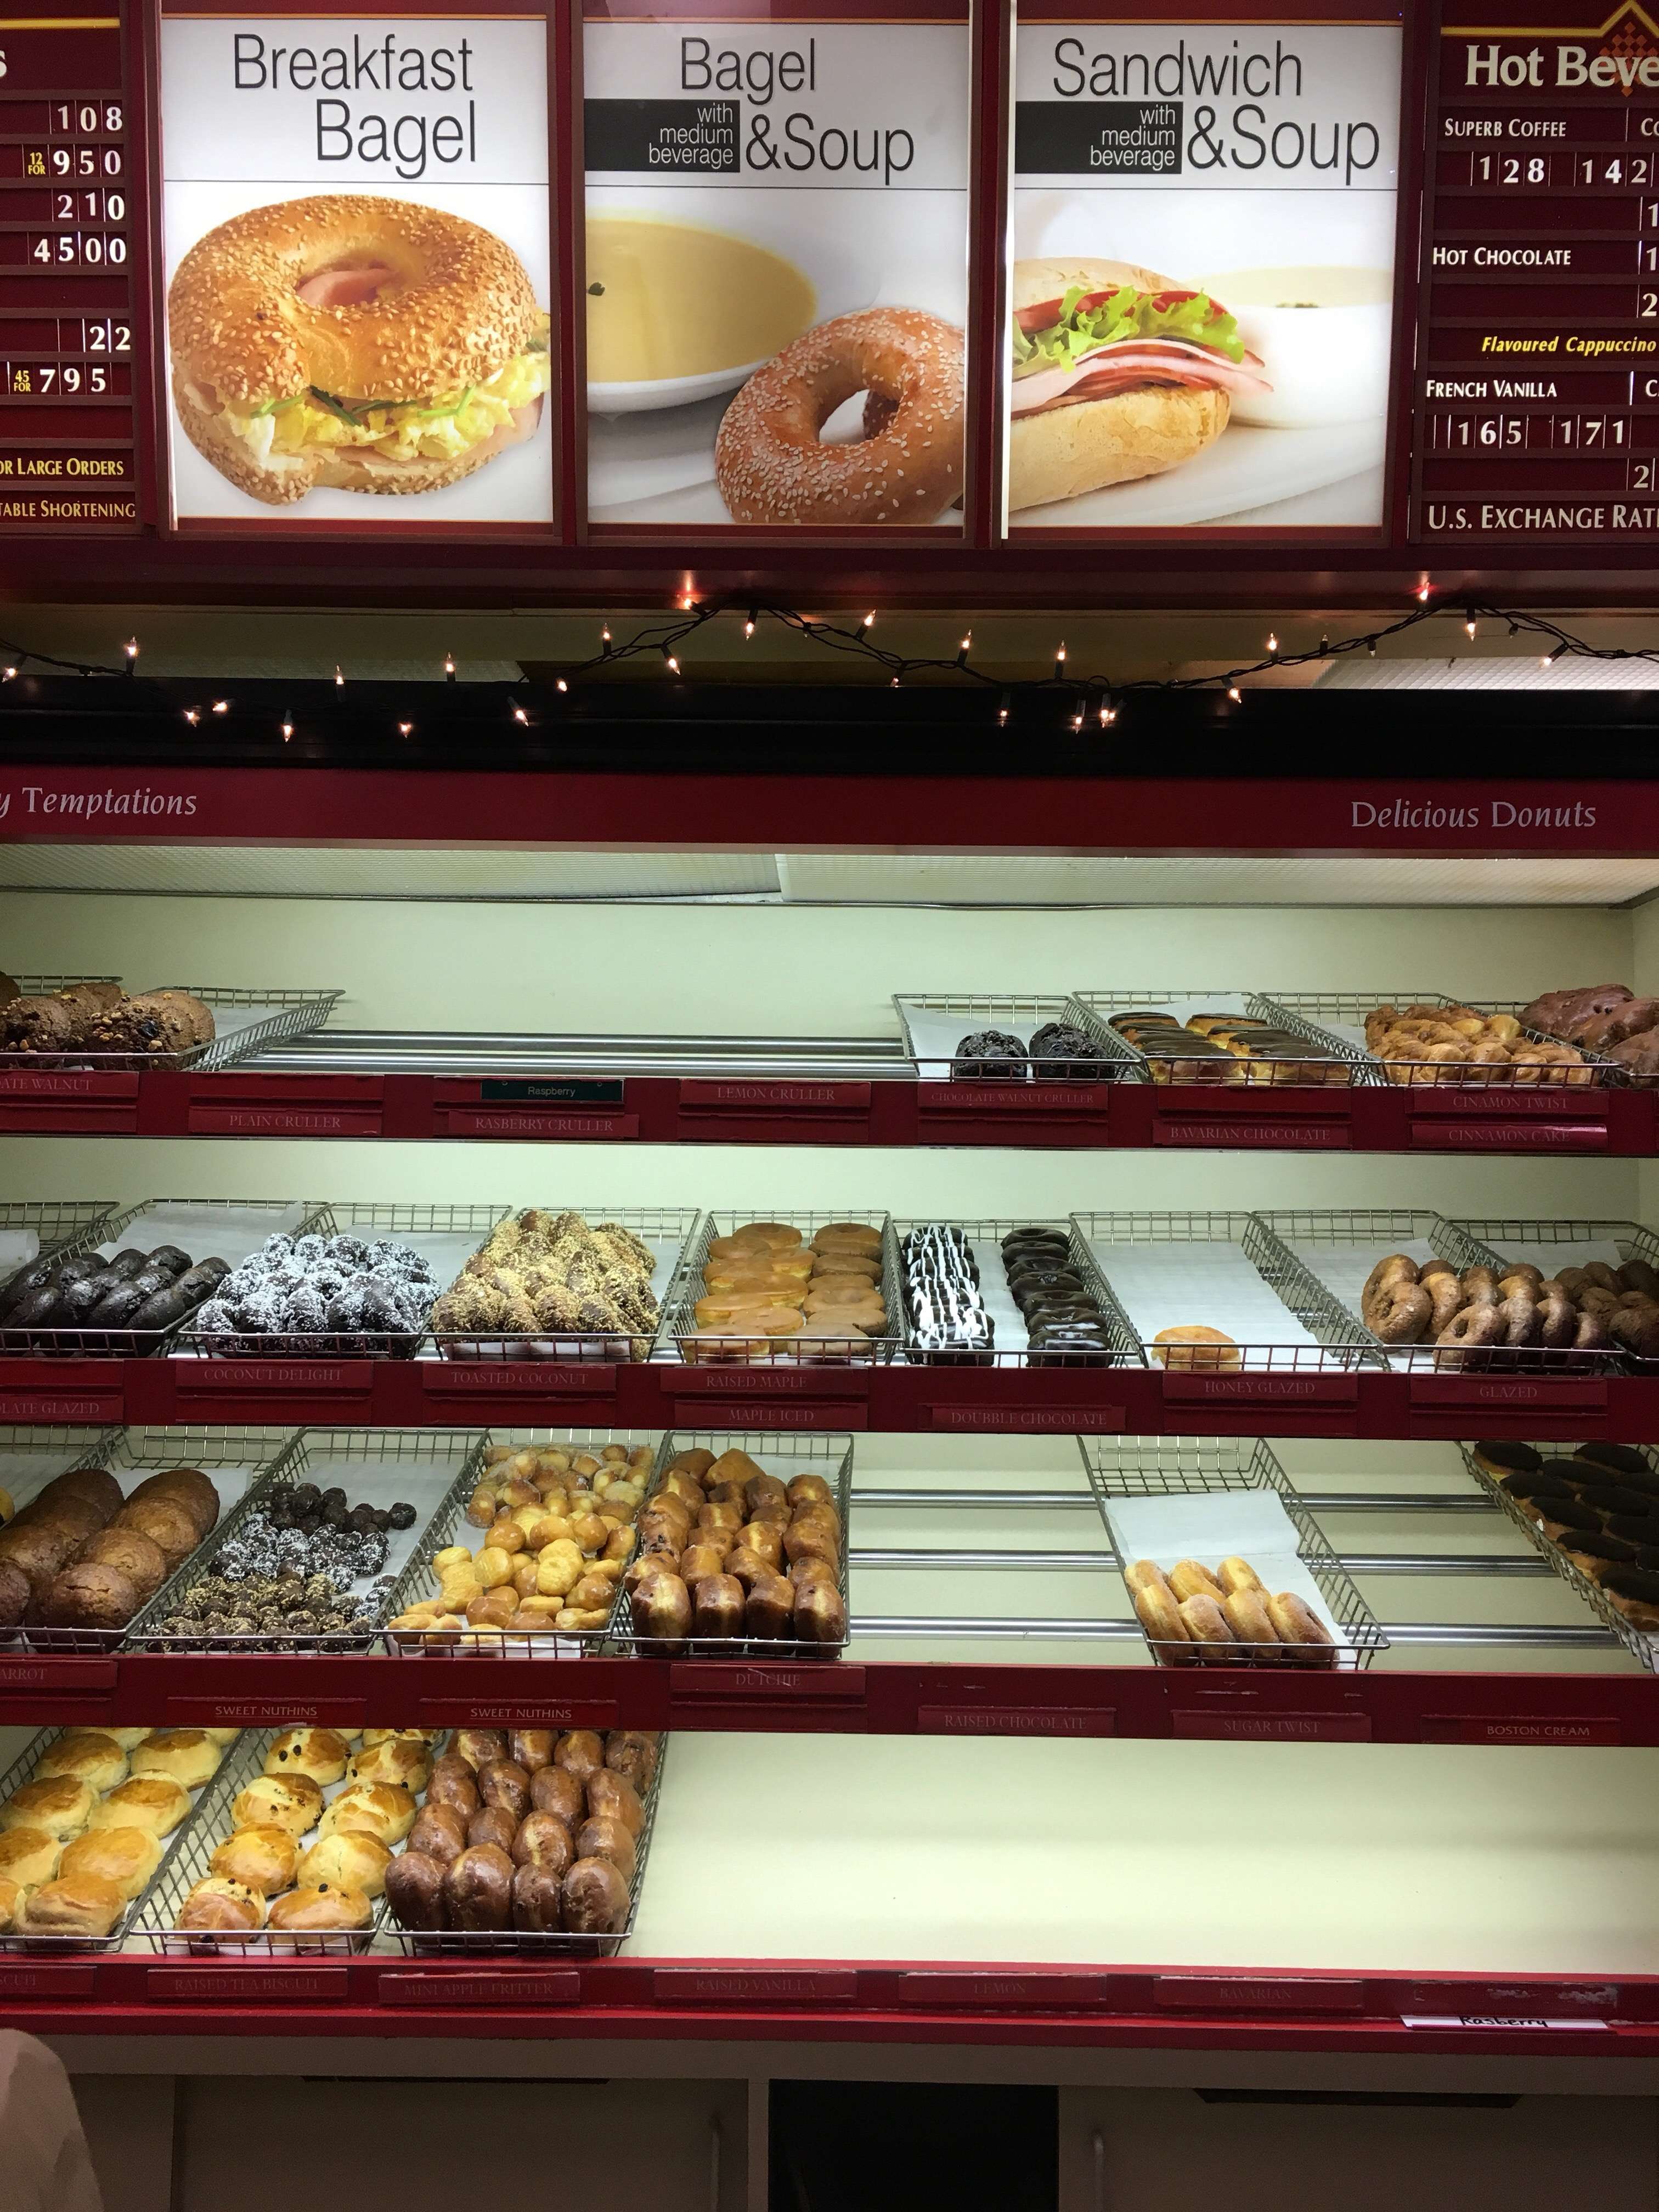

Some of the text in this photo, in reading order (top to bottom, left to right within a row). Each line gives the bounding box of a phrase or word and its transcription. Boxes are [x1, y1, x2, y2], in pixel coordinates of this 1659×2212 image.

[234, 33, 473, 92] Breakfast
[1053, 38, 1301, 97] Sandwich
[1465, 44, 1659, 88] Hot Beve
[681, 37, 815, 105] Bagel
[697, 103, 733, 123] with
[1140, 105, 1176, 125] with
[659, 125, 733, 144] medium
[1444, 118, 1566, 137] SUPERB COFFEE
[316, 99, 476, 179] Bagel
[1102, 126, 1176, 146] medium
[746, 113, 914, 185] &Soup
[1187, 104, 1379, 185] &Soup
[30, 152, 43, 166] 12
[649, 144, 733, 169] beverage
[1090, 145, 1176, 171] beverage
[28, 166, 46, 175] FOR
[1433, 247, 1571, 266] HOT CHOCOLATE
[1482, 336, 1656, 357] Flavoured Cappuccino
[15, 370, 29, 382] 45
[14, 382, 31, 392] FOR
[1426, 380, 1557, 397] FRENCH VANILLA
[18, 458, 63, 475] LARGE
[66, 457, 124, 476] ORDERS
[41, 500, 136, 518] SHORTENING
[1429, 504, 1659, 529] U.S. EXCHANGE RAT
[22, 787, 197, 820] Temptations
[1351, 798, 1596, 827] Delicious Donuts
[32, 1079, 92, 1091] WALNUT
[527, 1086, 576, 1098] Raspberry
[717, 1087, 836, 1100] LEMON CRULLER
[931, 1092, 1094, 1103] CHOCOLATE WALNUT CRULLER
[1453, 1096, 1569, 1109] CINAMON TWIST
[229, 1115, 342, 1128] PLAIN CRULLER
[475, 1117, 614, 1131] RASBERRY CRULLER
[1171, 1127, 1331, 1141] BAVARIAN CHOCOLATE
[1449, 1130, 1571, 1142] CINNAMON CAKE
[204, 1368, 343, 1381] COCONUT DELIGHT
[450, 1371, 589, 1385] TOASTED COCONUT
[706, 1375, 807, 1388] RAISED MAPLE
[1205, 1381, 1315, 1394] HONEY GLAZED
[1480, 1386, 1538, 1398] GLAZED
[41, 1402, 99, 1414] GLAZED
[729, 1409, 815, 1421] MAPLE ICED
[951, 1412, 1107, 1425] DOUBBLE CHOCOLATE
[215, 1706, 318, 1716] SWEET NUTHINS
[470, 1707, 572, 1719] SWEET NUTHINS
[944, 1715, 1087, 1729] RAISED CHOCOLATE
[1224, 1720, 1321, 1734] SUGAR TWIST
[1487, 1726, 1590, 1736] BOSTON CREAM
[1460, 2015, 1549, 2028] Rasberry
